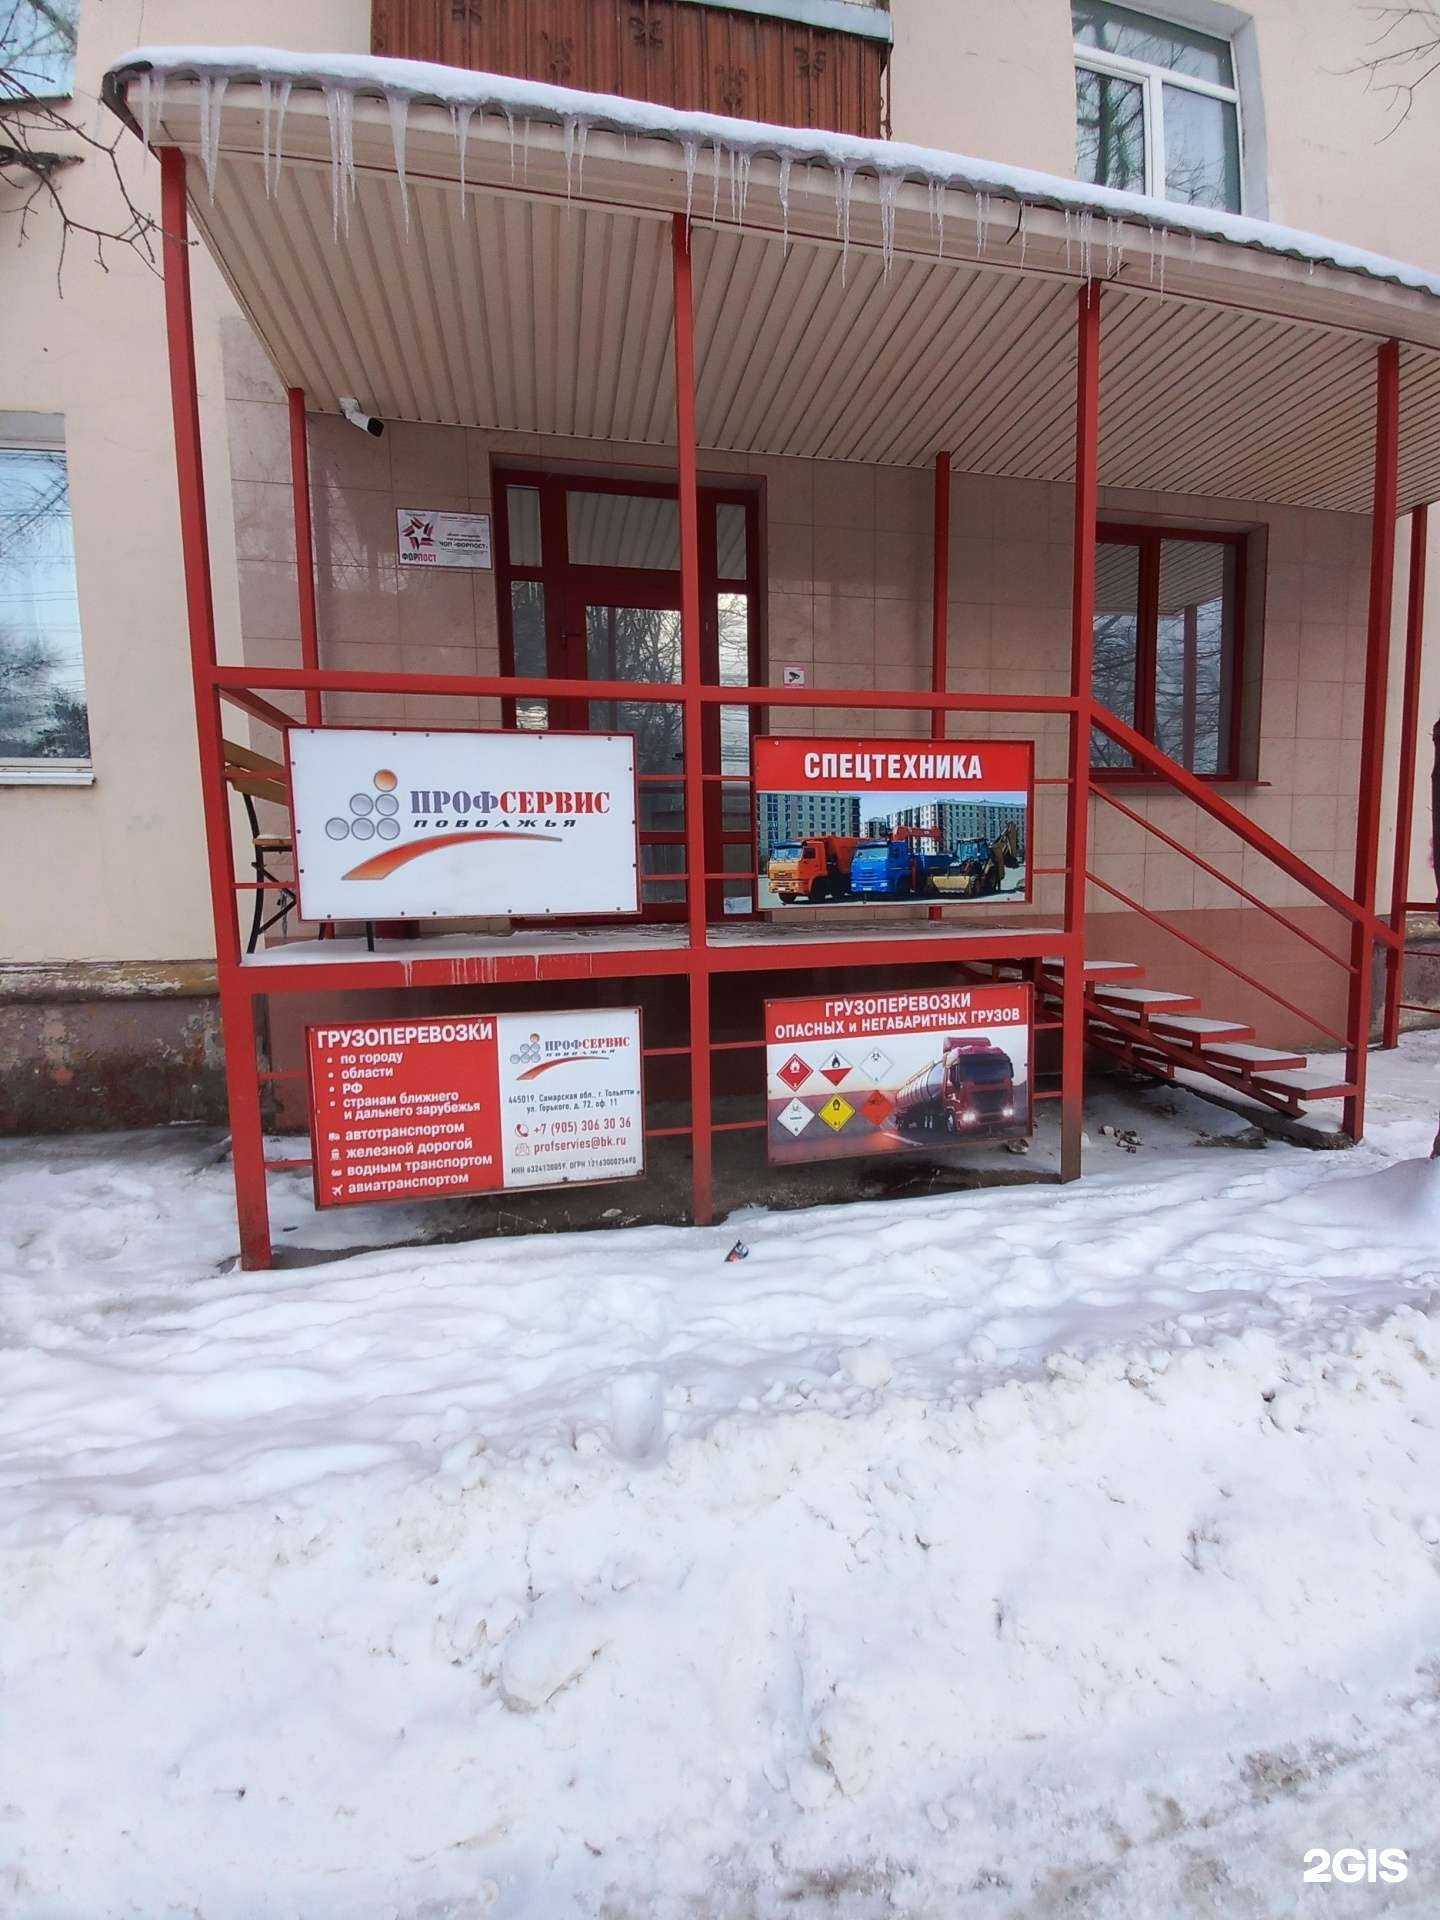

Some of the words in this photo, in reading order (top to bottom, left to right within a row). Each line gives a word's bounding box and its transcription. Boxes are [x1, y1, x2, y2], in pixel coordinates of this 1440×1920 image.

[402, 552, 436, 562] ФОРПОСТ
[804, 752, 981, 781] СПЕЦТЕХНИКА
[410, 790, 610, 814] ПРОФСЕРВИС
[413, 819, 577, 828] ПОВОЛЖЬЯ
[825, 992, 971, 1017] ГРУЗОПЕРЕВОЗКИ
[775, 1019, 844, 1039] ОПАСНЫХ
[862, 1012, 967, 1032] НЕГАБАРИТНЫХ
[971, 1008, 1020, 1023] ГРУЗОВ
[317, 1022, 493, 1048] ГРУЗОПЕРЕВОЗКИ
[545, 1036, 630, 1051] ПРОФСЕРВИС
[340, 1054, 356, 1064] по
[359, 1051, 403, 1065] городу
[341, 1067, 393, 1079] области
[342, 1083, 363, 1094] РФ
[343, 1096, 396, 1109] странам
[400, 1091, 459, 1104] ближнего
[539, 1094, 578, 1103] Самарская
[344, 1111, 352, 1120] и
[355, 1107, 413, 1121] дальнего
[416, 1101, 481, 1117] зарубежья
[346, 1122, 465, 1141] автотранспортом
[534, 1123, 546, 1134] +7
[551, 1121, 577, 1136] (905)
[581, 1120, 600, 1132] 306
[604, 1118, 616, 1130] 30
[619, 1117, 631, 1128] 36
[346, 1142, 414, 1159] железной
[417, 1137, 473, 1154] дорогой
[347, 1162, 401, 1177] водным
[405, 1154, 493, 1171] транспортом
[348, 1173, 469, 1194] авиатранспортом
